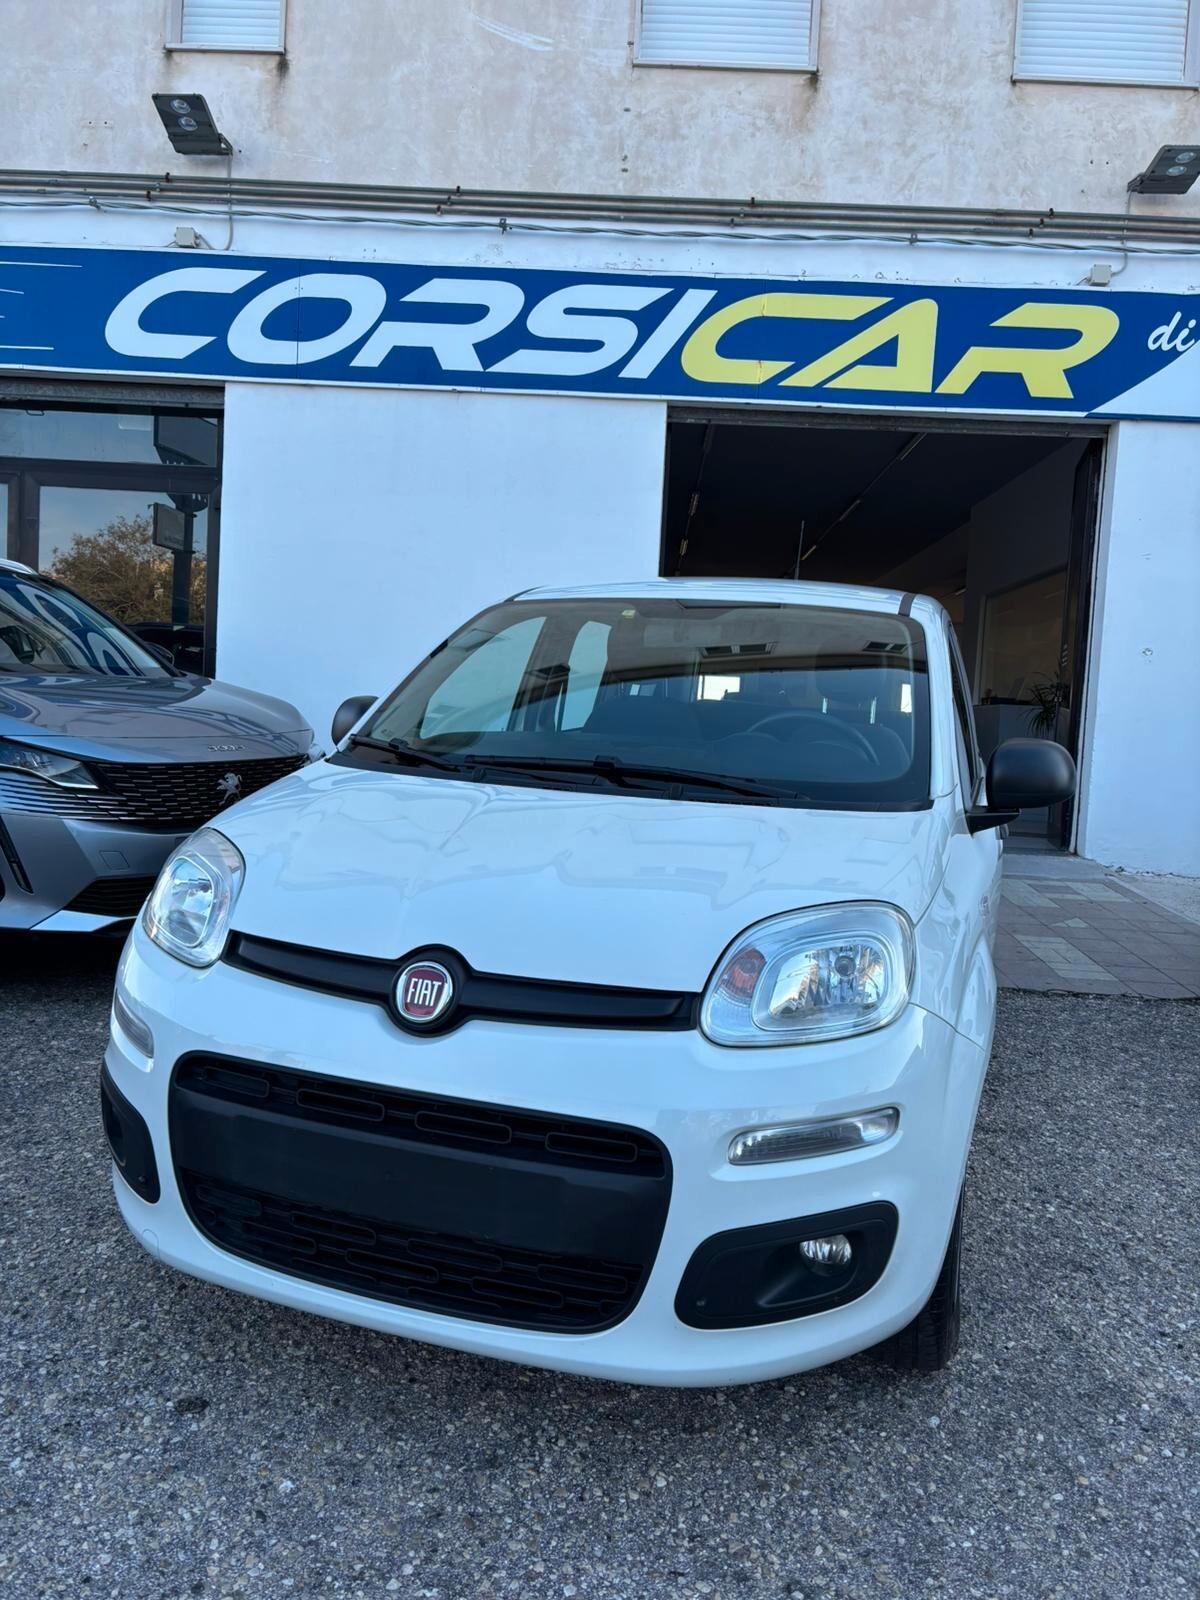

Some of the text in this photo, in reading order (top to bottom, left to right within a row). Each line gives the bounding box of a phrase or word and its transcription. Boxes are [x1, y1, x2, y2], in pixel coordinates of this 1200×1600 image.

[105, 267, 1197, 399] CORSICAR di
[406, 977, 442, 1007] FIAT
